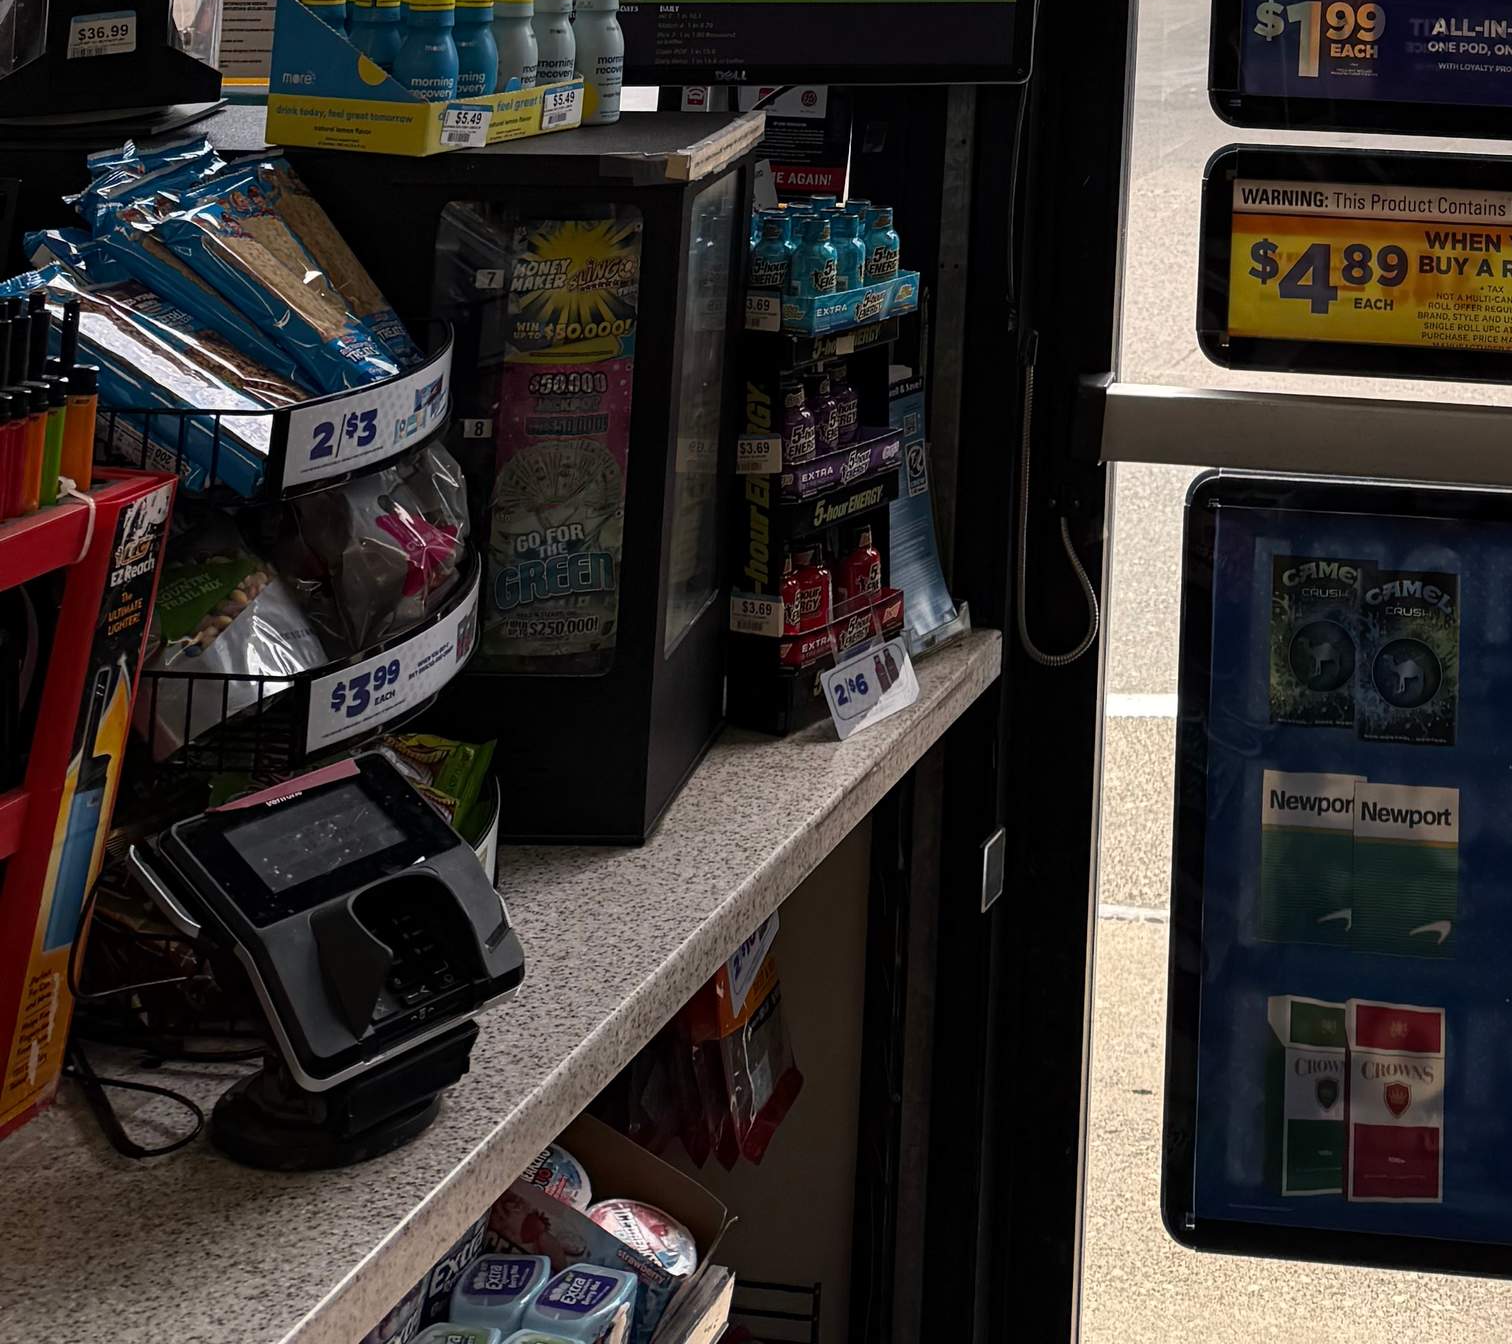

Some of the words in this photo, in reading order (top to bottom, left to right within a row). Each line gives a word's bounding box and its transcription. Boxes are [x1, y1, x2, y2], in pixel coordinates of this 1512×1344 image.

[78, 24, 129, 42] $36.99
[1329, 43, 1379, 59] EACH
[410, 76, 455, 89] morning
[552, 92, 576, 107] $5.49
[455, 111, 483, 126] $5.49
[787, 171, 833, 186] AGAIN!
[1241, 187, 1329, 209] WARNING:
[1333, 192, 1366, 211] This
[1371, 193, 1433, 214] Product
[1438, 197, 1506, 217] Contains
[1424, 230, 1503, 253] WHEN
[513, 257, 572, 275] MONEY
[1419, 255, 1468, 276] BUY
[1475, 258, 1494, 278] A
[511, 273, 567, 293] MAKER
[1353, 297, 1394, 311] EACH
[739, 439, 770, 454] $3.69
[515, 530, 541, 553] GO
[545, 522, 585, 545] FOR
[494, 551, 617, 611] GREEN
[1364, 579, 1456, 615] CAMEL
[742, 600, 773, 616] $3.69
[1360, 801, 1453, 828] Newport
[1361, 1059, 1435, 1084] CROWNS
